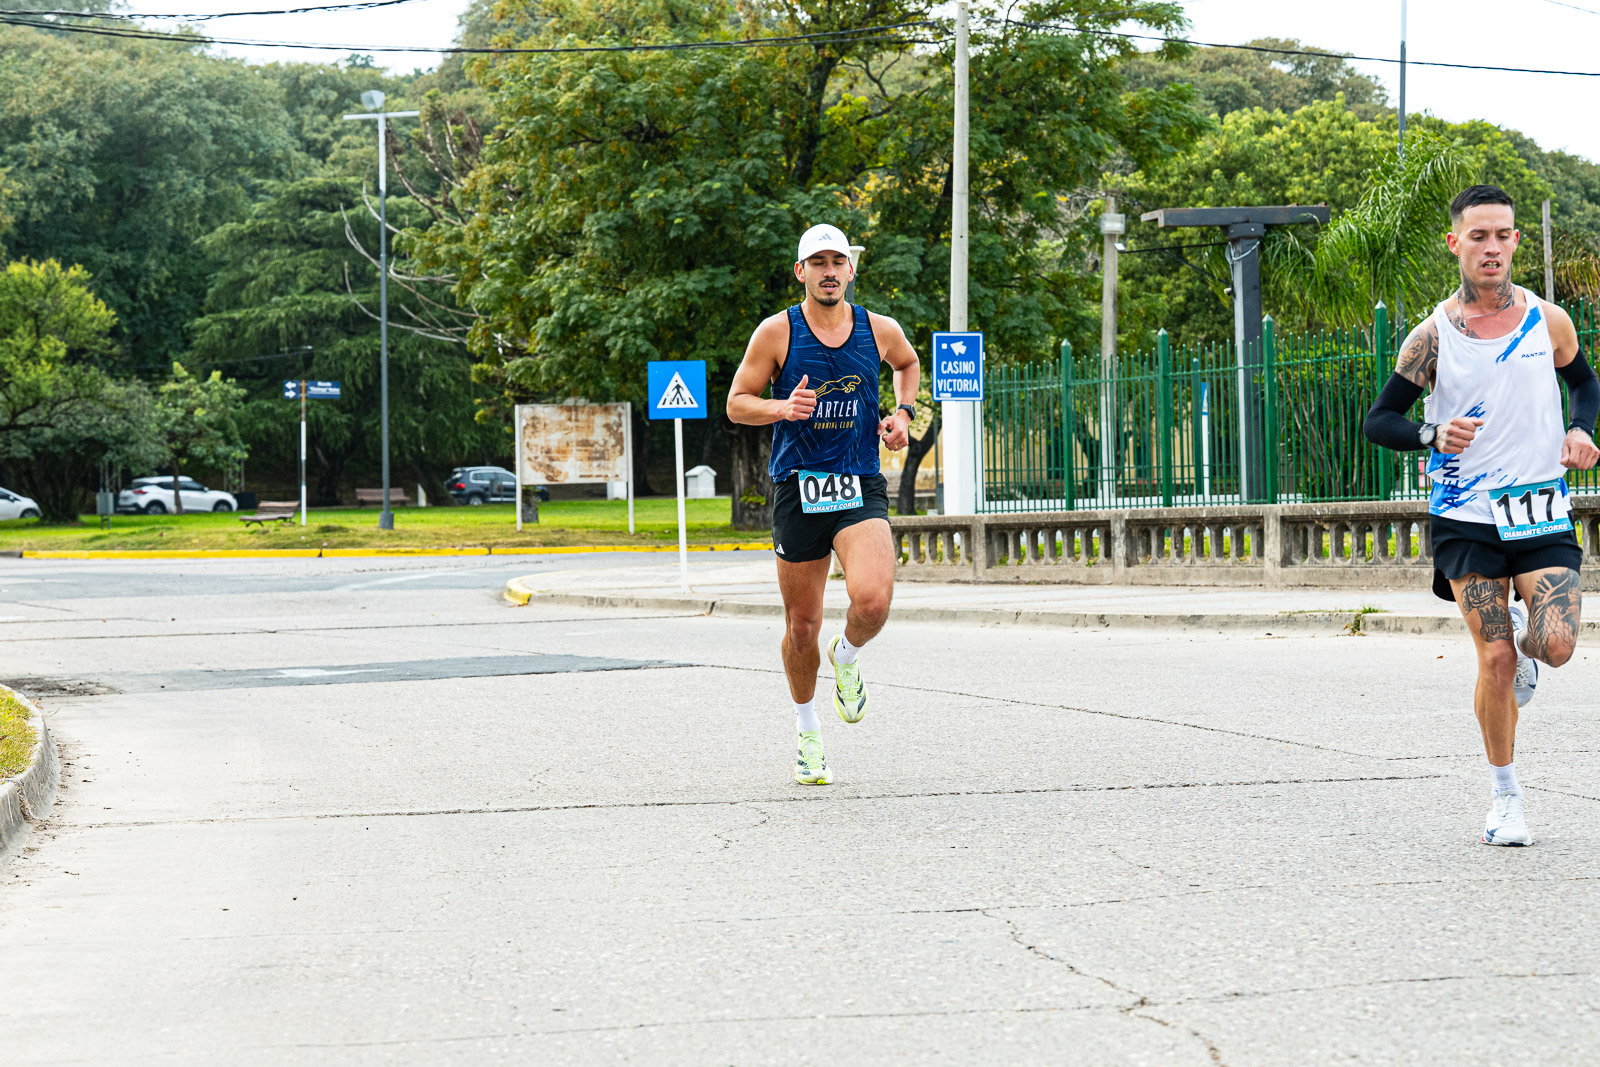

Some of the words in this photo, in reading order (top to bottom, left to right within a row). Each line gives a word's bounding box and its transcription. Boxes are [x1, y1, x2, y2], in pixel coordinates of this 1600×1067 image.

[941, 361, 975, 374] CASINO
[937, 379, 979, 392] VICTORIA
[810, 399, 859, 418] ARTLEK
[803, 472, 857, 505] 048
[806, 504, 838, 512] DIAMANTE
[839, 501, 861, 509] CORRE
[1496, 487, 1556, 529] 117
[1504, 528, 1541, 538] DIAMANTE
[1543, 523, 1568, 532] CORRE
